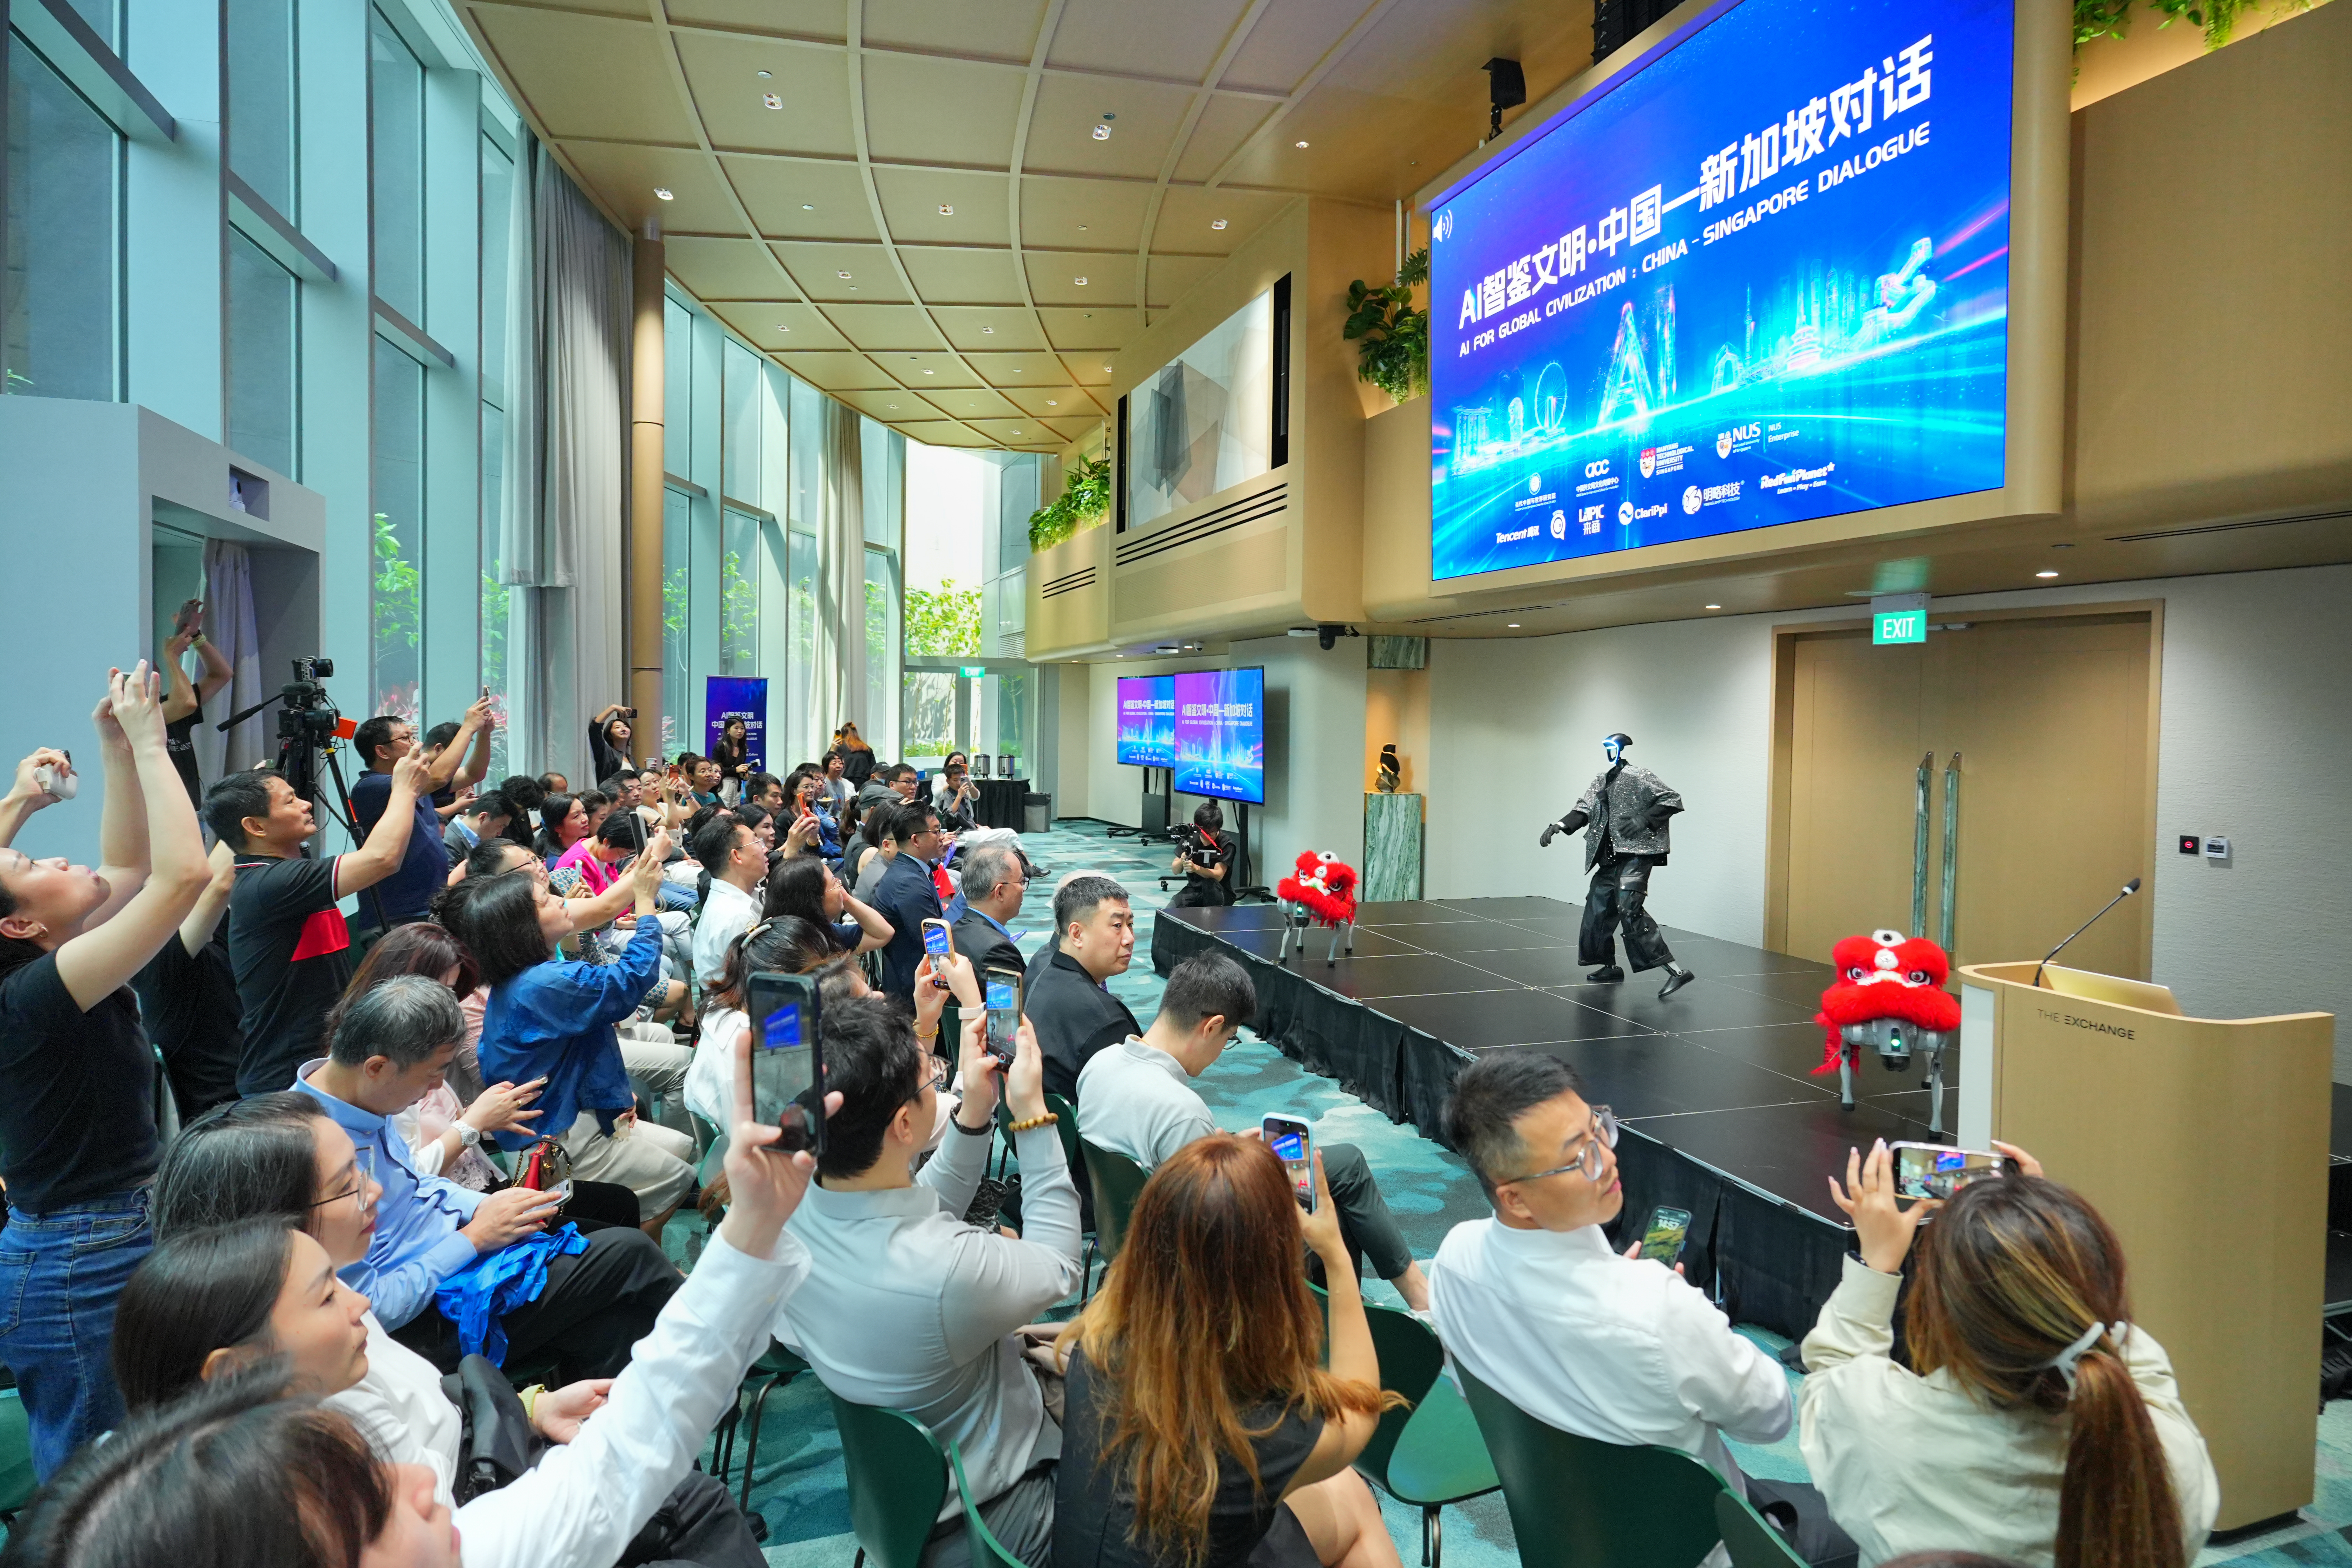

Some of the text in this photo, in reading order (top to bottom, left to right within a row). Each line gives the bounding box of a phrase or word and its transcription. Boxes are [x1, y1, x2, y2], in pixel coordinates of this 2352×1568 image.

[1459, 342, 1469, 357] AI
[1473, 329, 1494, 351] FOR
[1499, 308, 1541, 339] GLOBAL
[1546, 267, 1626, 317] CIVILIZATION
[1642, 239, 1688, 273] CHINA
[1703, 180, 1809, 246] SINGAPORE
[1818, 121, 1930, 193] DIALOGUE
[1733, 421, 1761, 442] NUS
[1768, 422, 1781, 432] NUS
[1768, 430, 1799, 443] Enterprise
[1656, 442, 1679, 453] NANYANG
[1656, 445, 1694, 460] TECHNOLOGICAL
[1656, 455, 1683, 467] UNIVERSITY
[1656, 464, 1683, 475] SINGAPORE
[1760, 467, 1827, 489] RedFunPlanet
[1703, 481, 1740, 501] 明略科技
[1635, 503, 1667, 519] ClariPpi
[1583, 520, 1600, 535] 来画
[1496, 528, 1527, 544] Tencent
[1883, 617, 1915, 639] EXIT
[965, 668, 979, 676] EXIT
[2038, 1009, 2135, 1040] THE EXCHANGE
